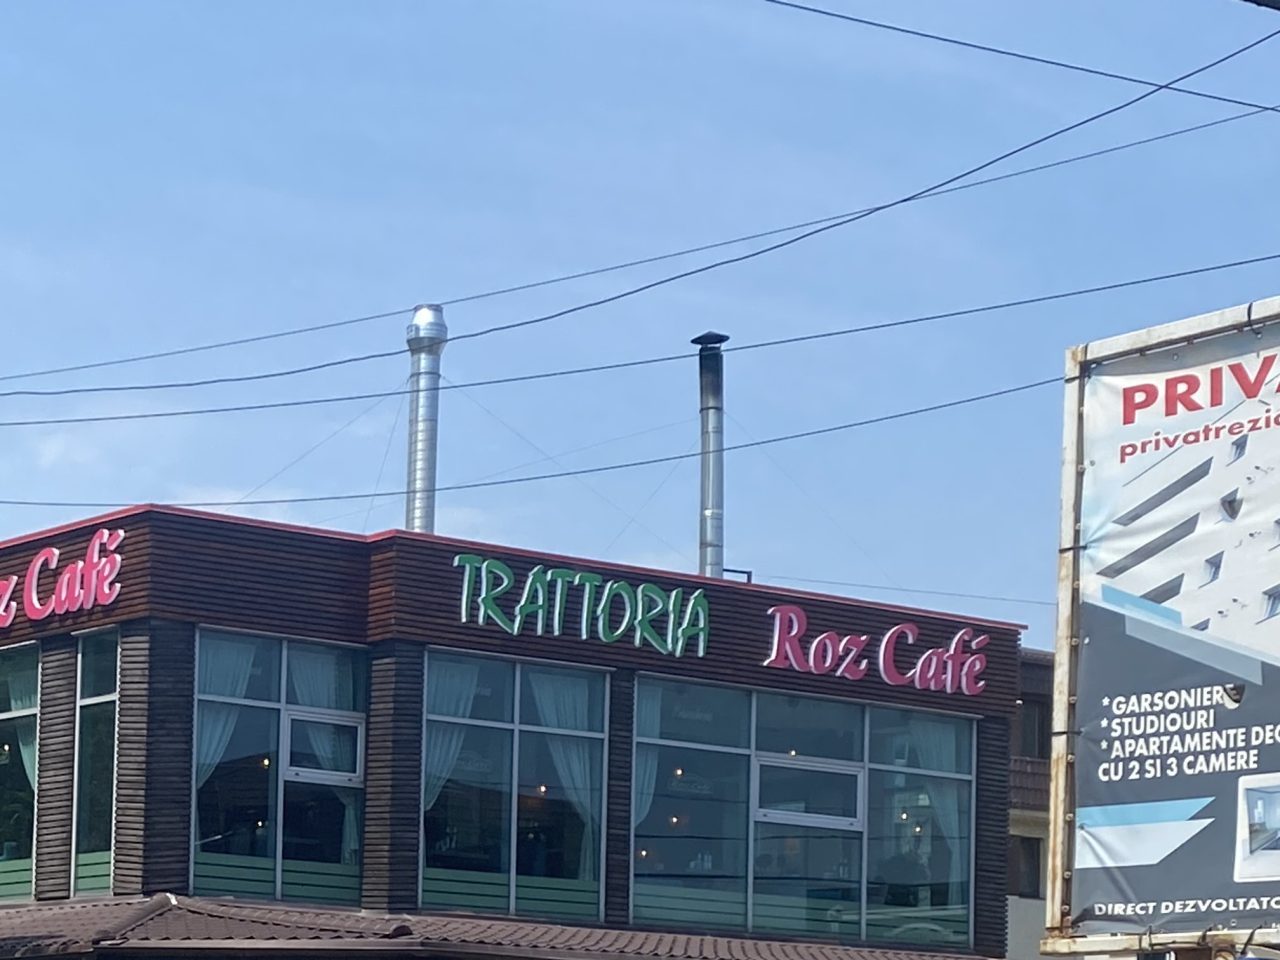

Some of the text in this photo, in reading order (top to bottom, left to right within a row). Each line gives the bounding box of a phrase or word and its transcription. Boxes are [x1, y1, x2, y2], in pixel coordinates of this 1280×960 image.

[1122, 353, 1280, 426] PRIV
[24, 528, 125, 620] Café
[453, 553, 710, 658] TRATTORIA
[763, 605, 990, 696] Roz Café
[1110, 709, 1215, 737] STUDIOURI
[1110, 728, 1246, 759] APARTAMENTE
[1098, 749, 1259, 782] CU 2 SI 3 CAMERE
[1094, 902, 1157, 916] DIRECT
